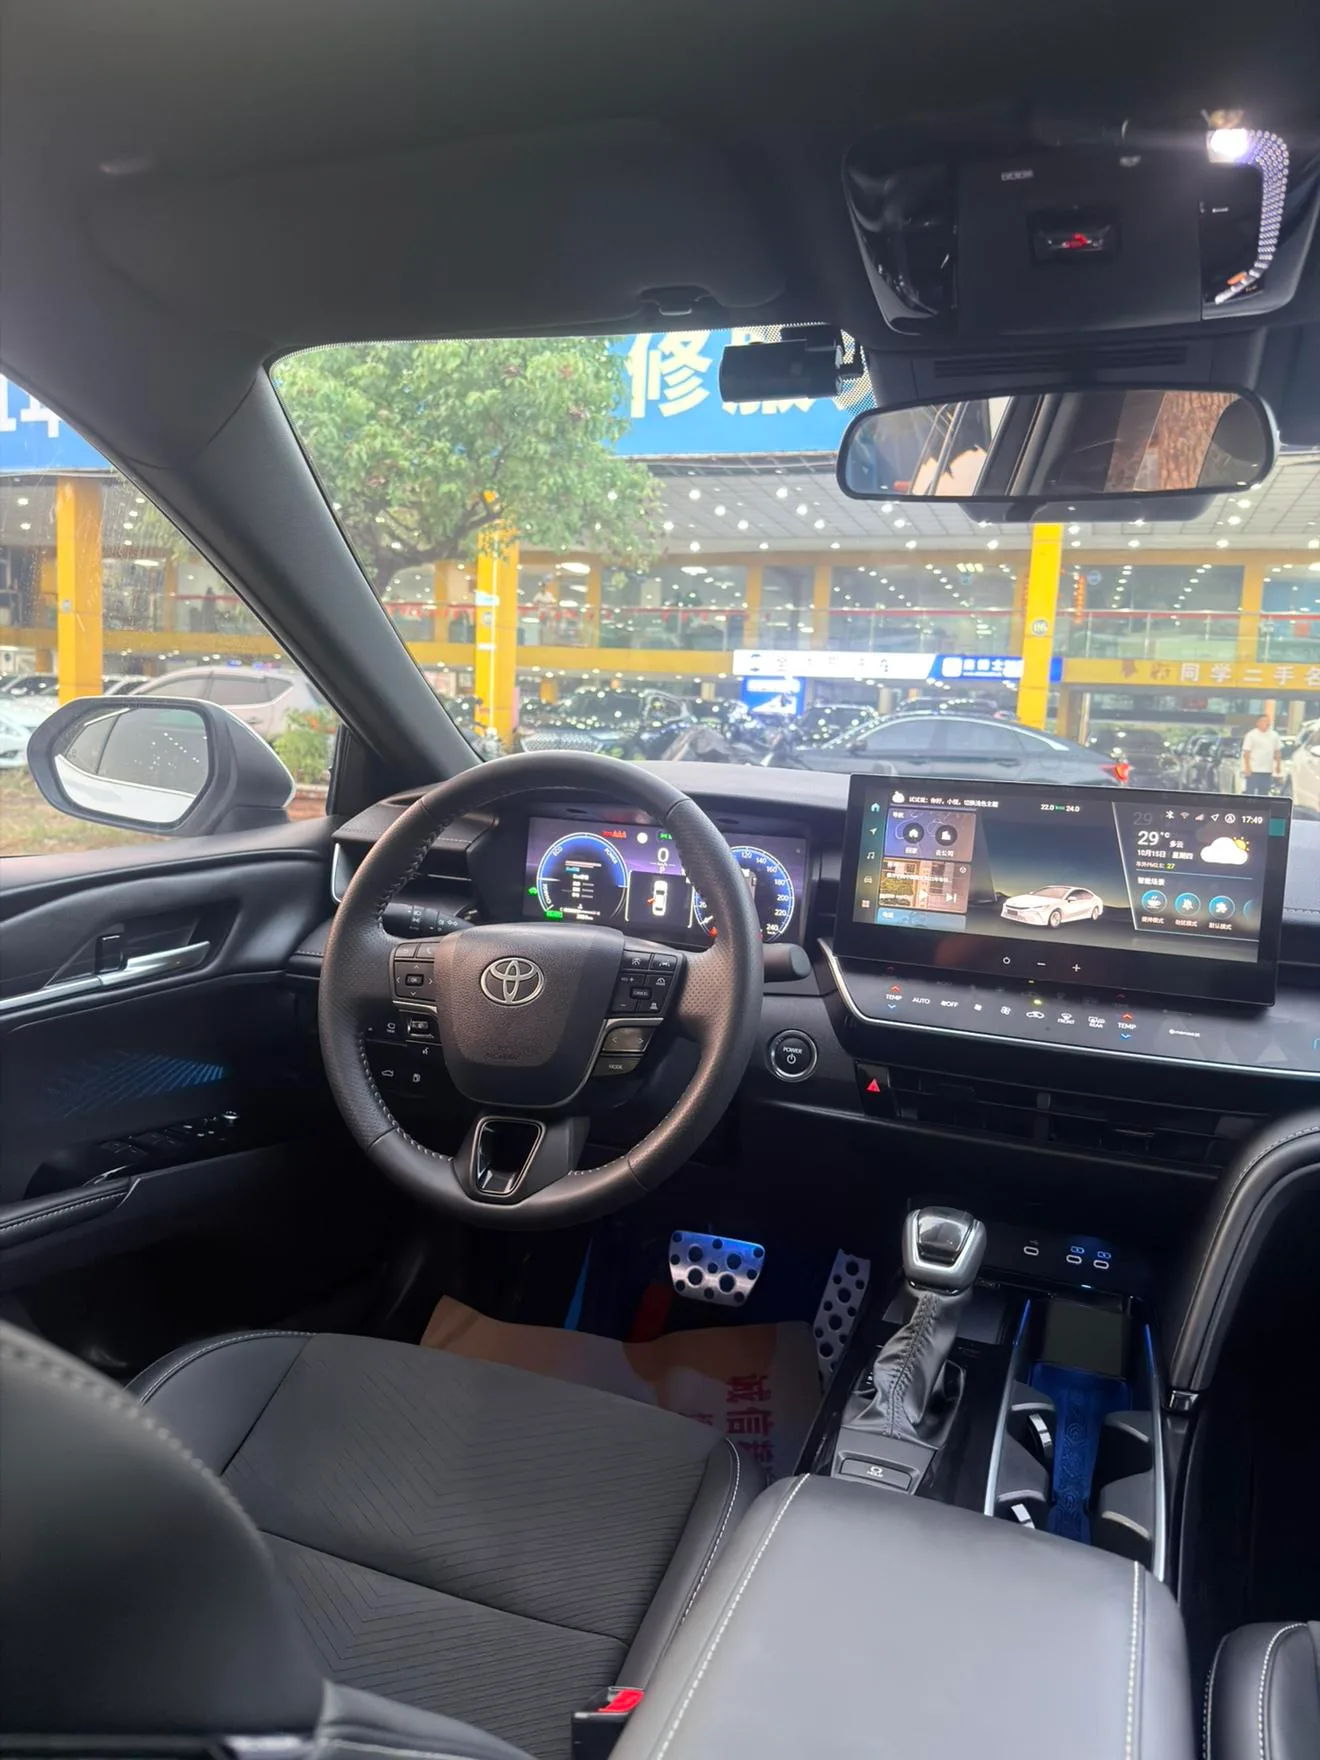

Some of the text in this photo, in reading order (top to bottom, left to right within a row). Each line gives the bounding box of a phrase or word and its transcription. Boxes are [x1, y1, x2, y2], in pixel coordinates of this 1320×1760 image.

[1241, 815, 1263, 824] 17:49
[1137, 830, 1160, 846] 29
[657, 847, 670, 863] 0
[741, 851, 753, 859] 120
[756, 857, 768, 865] 140
[776, 894, 789, 902] 200
[774, 909, 787, 917] 220
[766, 923, 779, 932] 240
[912, 997, 931, 1005] AUTO
[1117, 1022, 1137, 1030] TEMP
[782, 1046, 803, 1054] POWER
